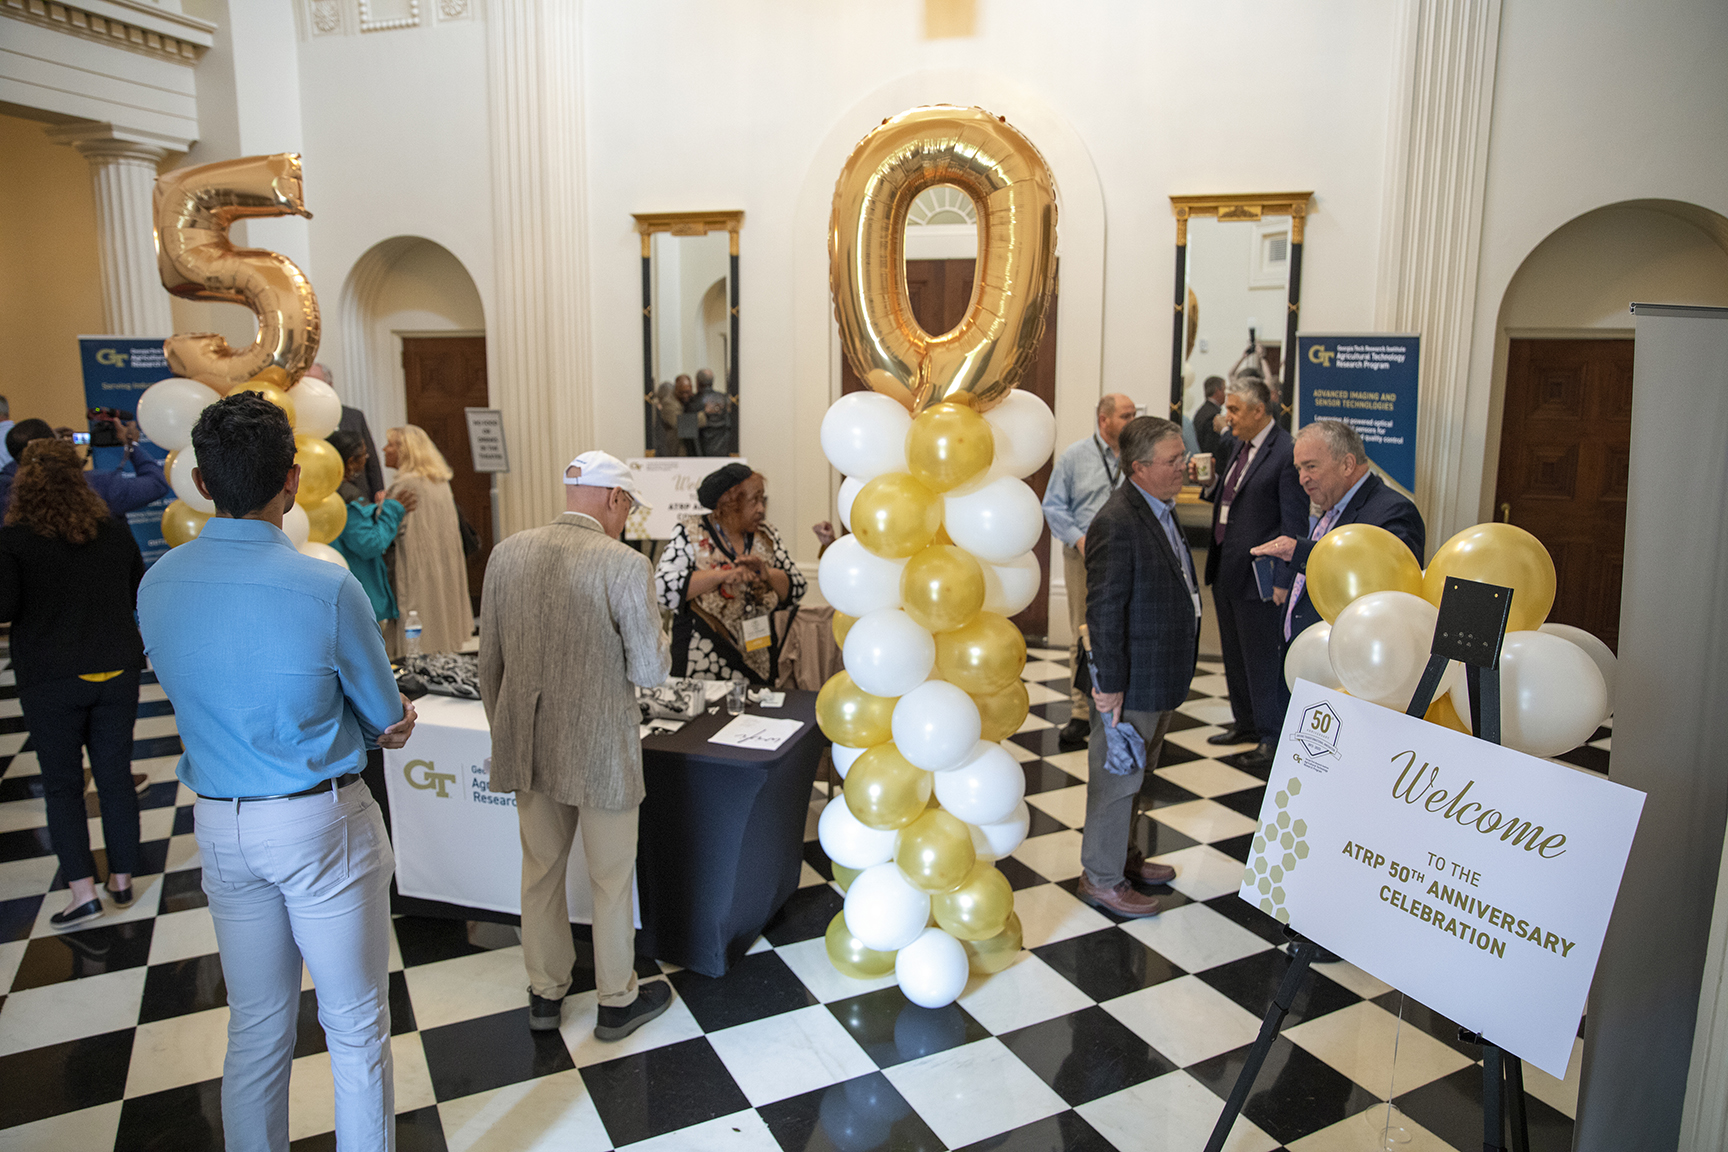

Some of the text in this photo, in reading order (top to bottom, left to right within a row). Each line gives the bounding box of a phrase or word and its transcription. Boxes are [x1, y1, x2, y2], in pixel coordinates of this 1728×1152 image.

[96, 348, 129, 368] GT
[1308, 345, 1335, 367] GT
[1336, 352, 1406, 363] Agricultural Technology
[1336, 360, 1390, 371] Research Program
[1313, 389, 1397, 402] ADVANCED IMAGING AND
[1314, 398, 1394, 411] SENSOR TECHNOLOGIES
[1364, 435, 1383, 444] quality
[1383, 436, 1404, 444] control
[1376, 426, 1387, 435] for
[403, 759, 457, 798] GT
[472, 791, 517, 807] Researc
[1390, 750, 1567, 859] Welcome
[1427, 851, 1482, 888] TO THE
[1341, 840, 1386, 870] ATRP
[1425, 880, 1577, 959] ANNIVERSARY
[1379, 884, 1508, 960] CELEBRATION
